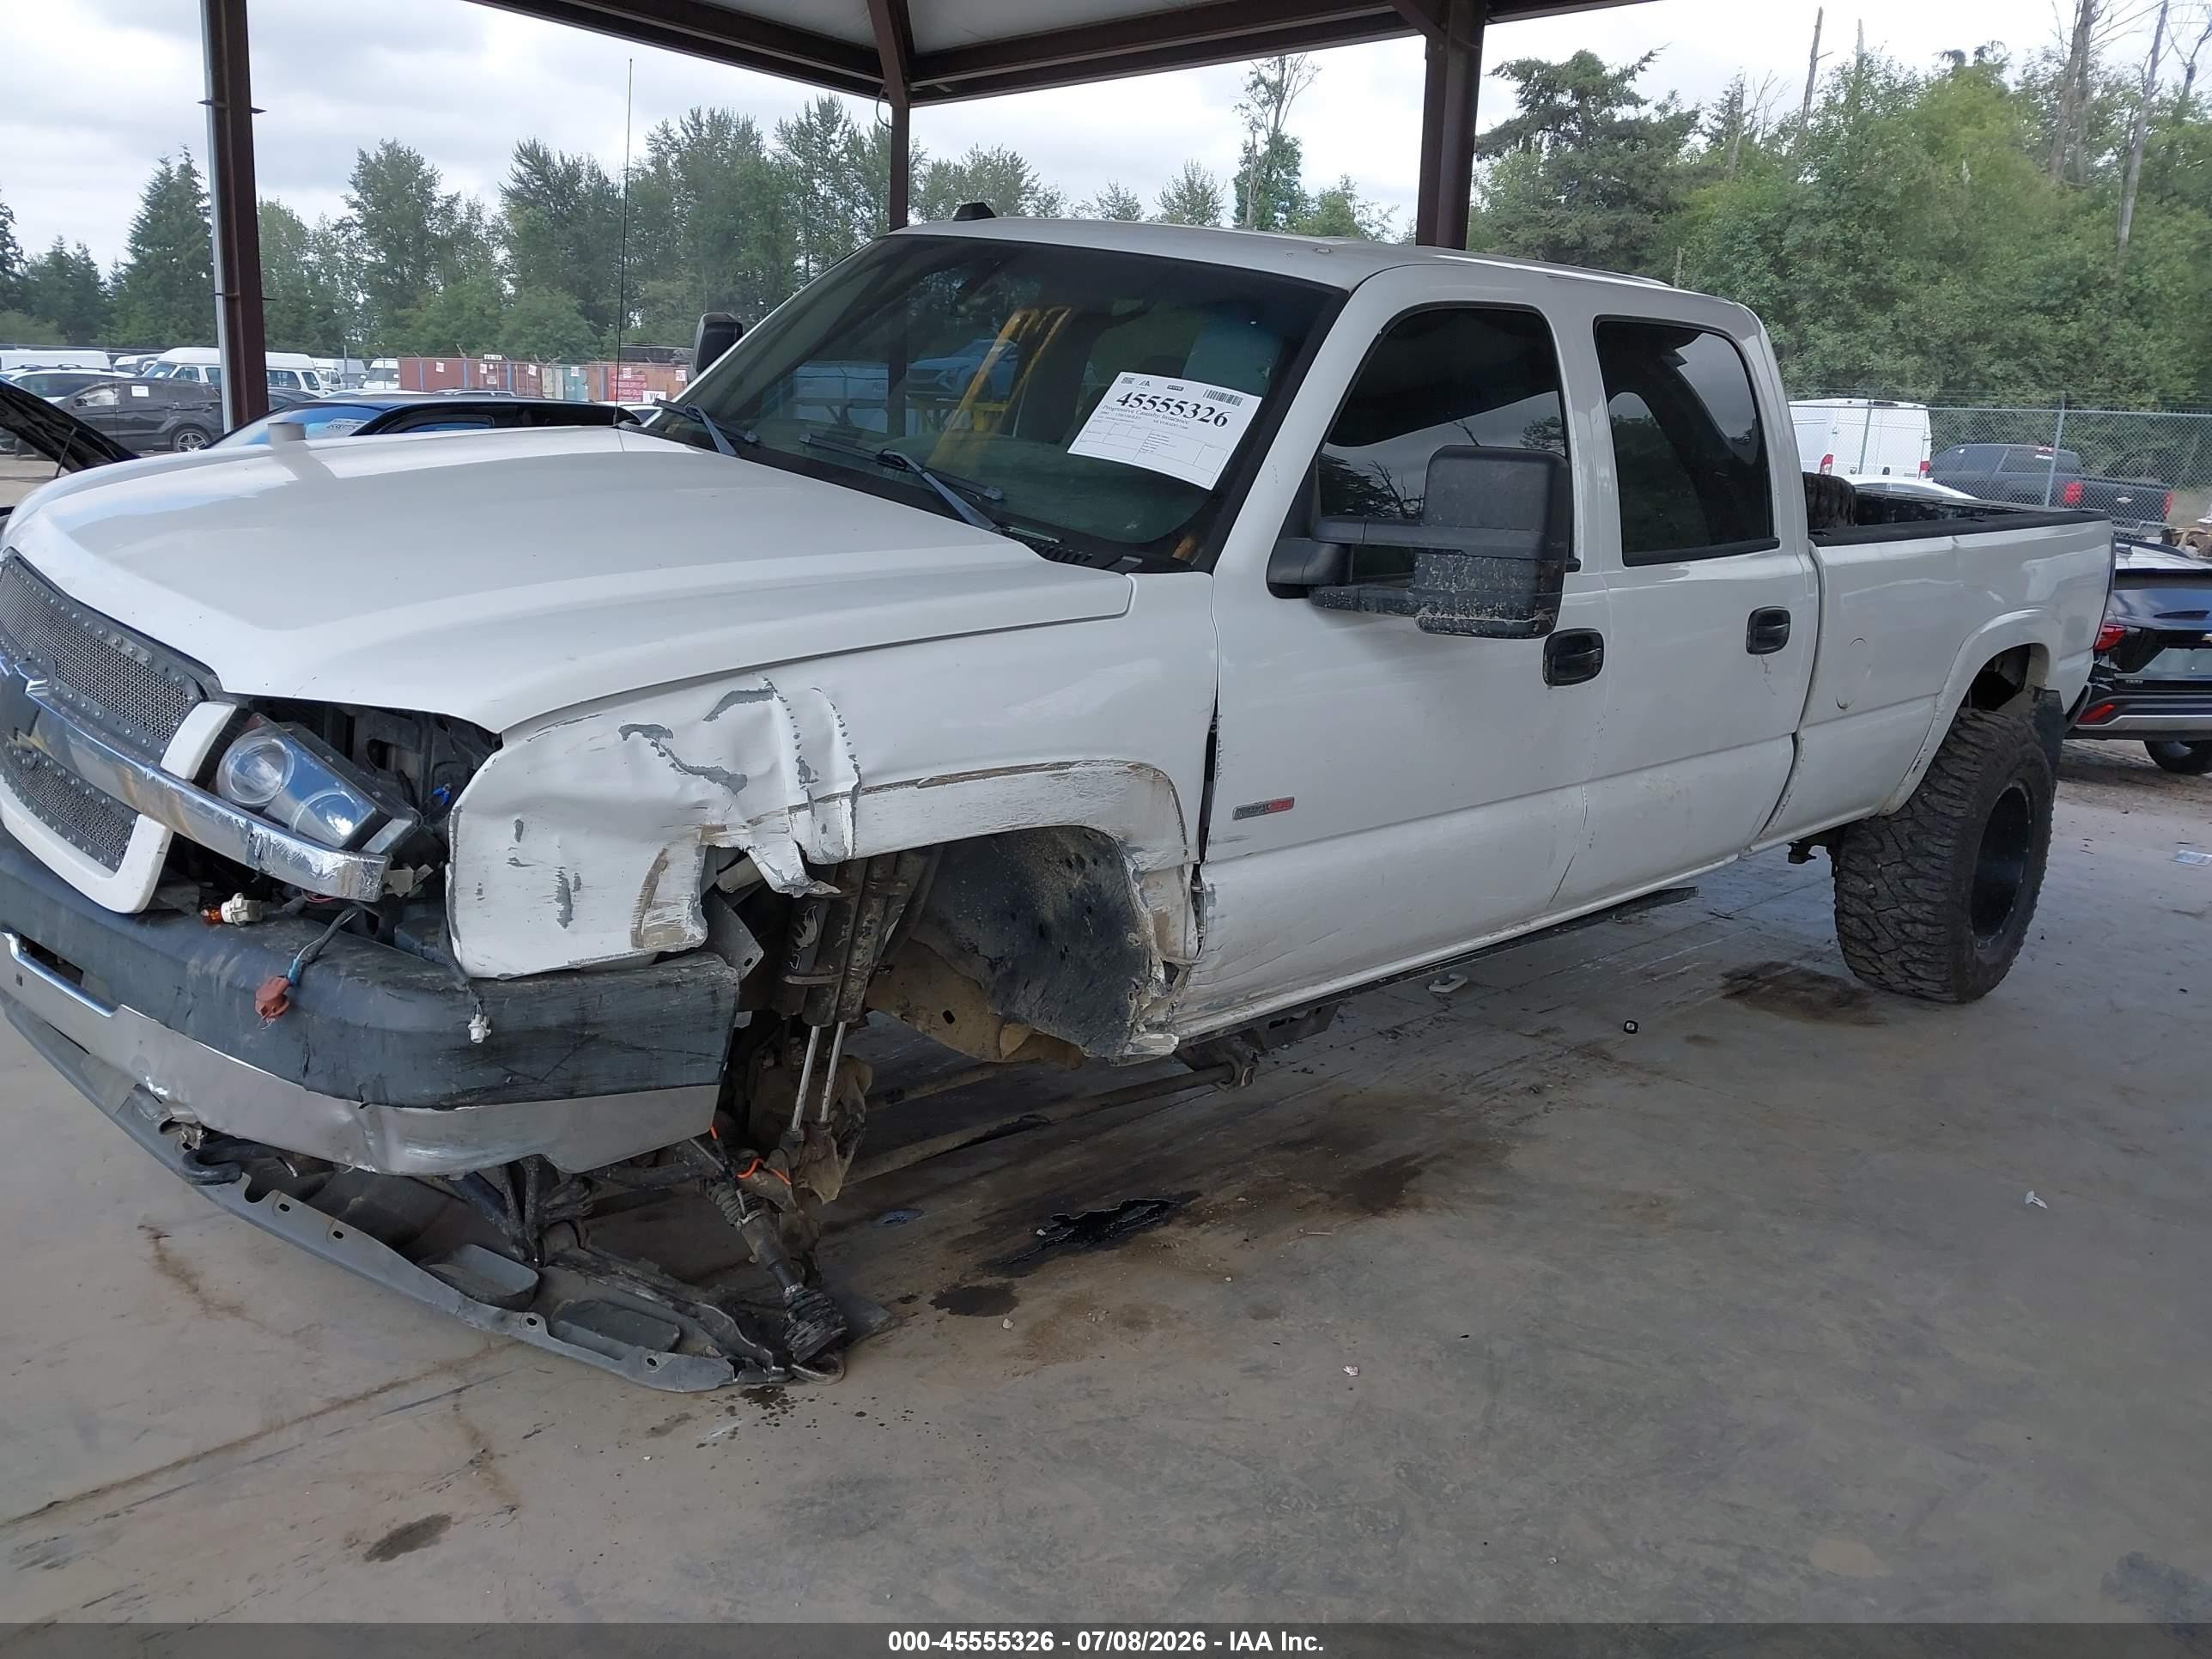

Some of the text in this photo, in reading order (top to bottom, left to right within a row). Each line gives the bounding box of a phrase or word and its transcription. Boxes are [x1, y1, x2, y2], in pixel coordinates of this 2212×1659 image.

[1103, 404, 1134, 415] Progressive
[1135, 409, 1160, 420] Casualty
[1161, 414, 1190, 425] Insurance
[1115, 391, 1232, 428] 45555326
